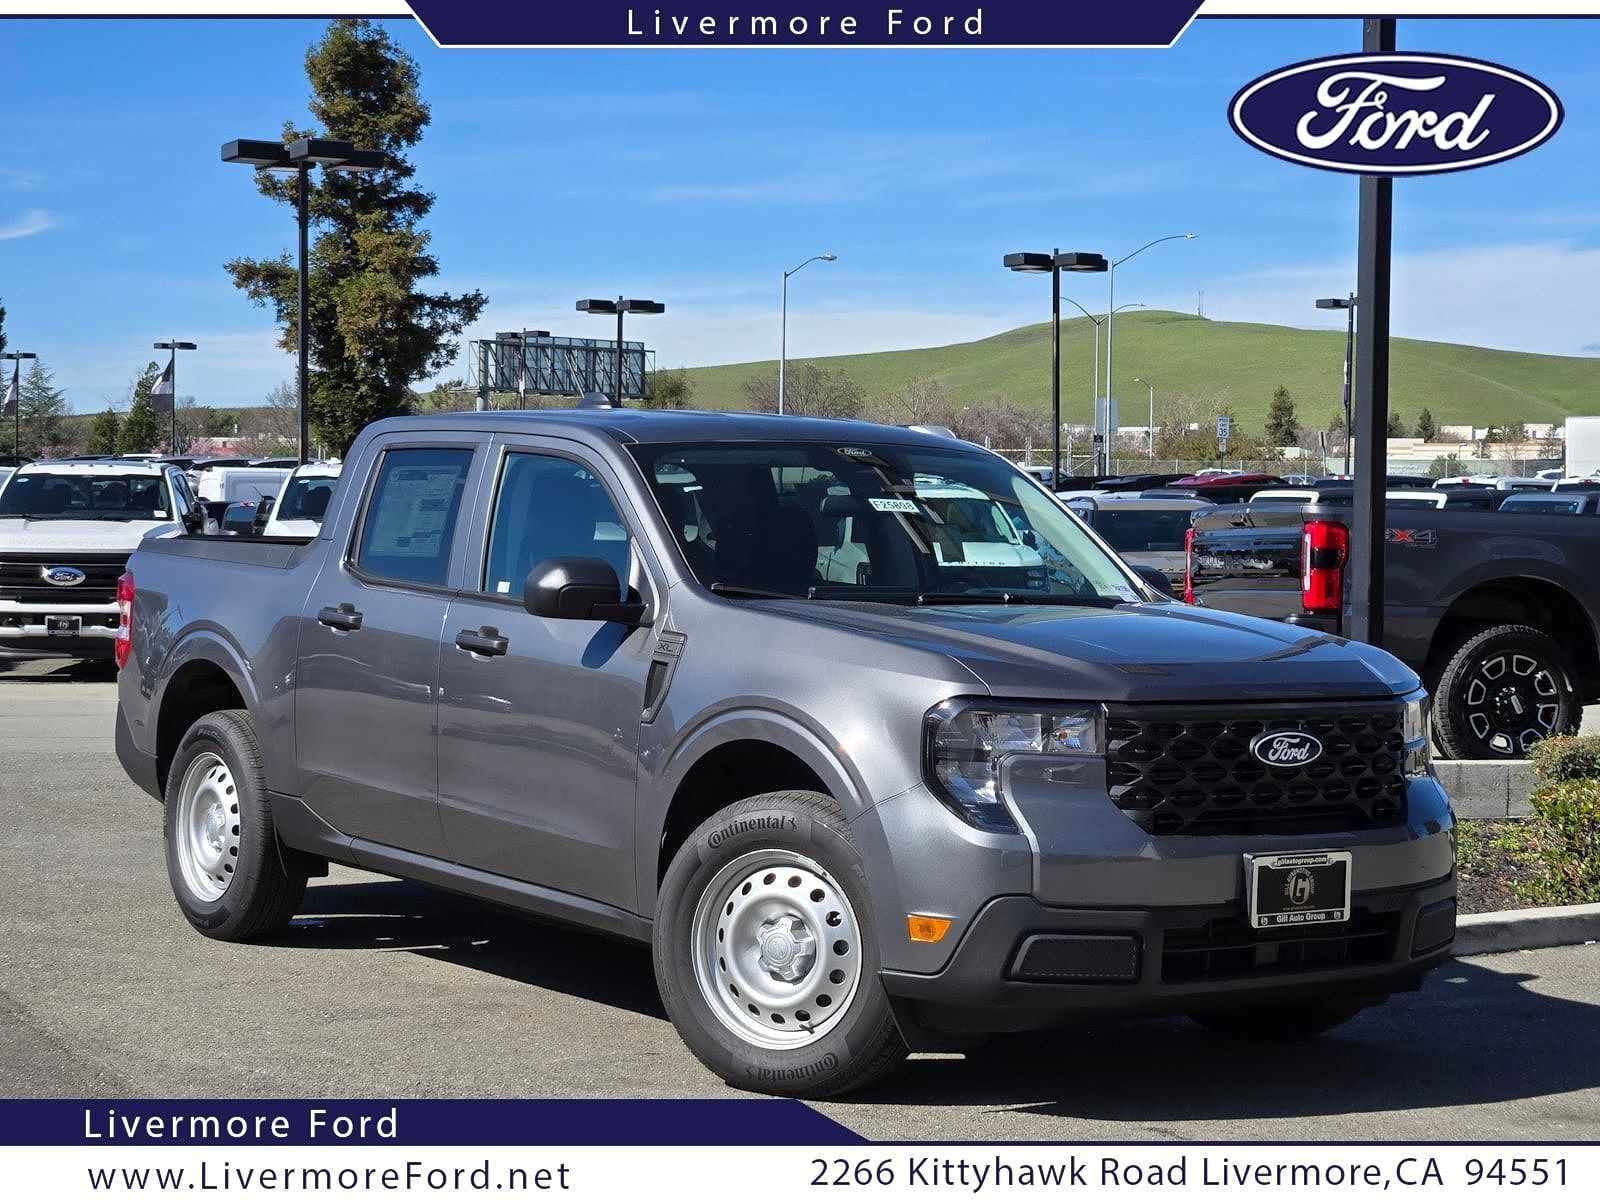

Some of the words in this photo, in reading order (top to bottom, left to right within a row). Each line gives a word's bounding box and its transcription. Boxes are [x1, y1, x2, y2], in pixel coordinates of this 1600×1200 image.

[1218, 427, 1228, 437] 35
[658, 643, 674, 652] XL
[1268, 737, 1310, 761] Ford
[707, 815, 786, 849] Continental
[1276, 914, 1289, 923] Gill
[1289, 914, 1305, 922] Auto
[1305, 912, 1326, 921] Group
[757, 1052, 839, 1081] Continental
